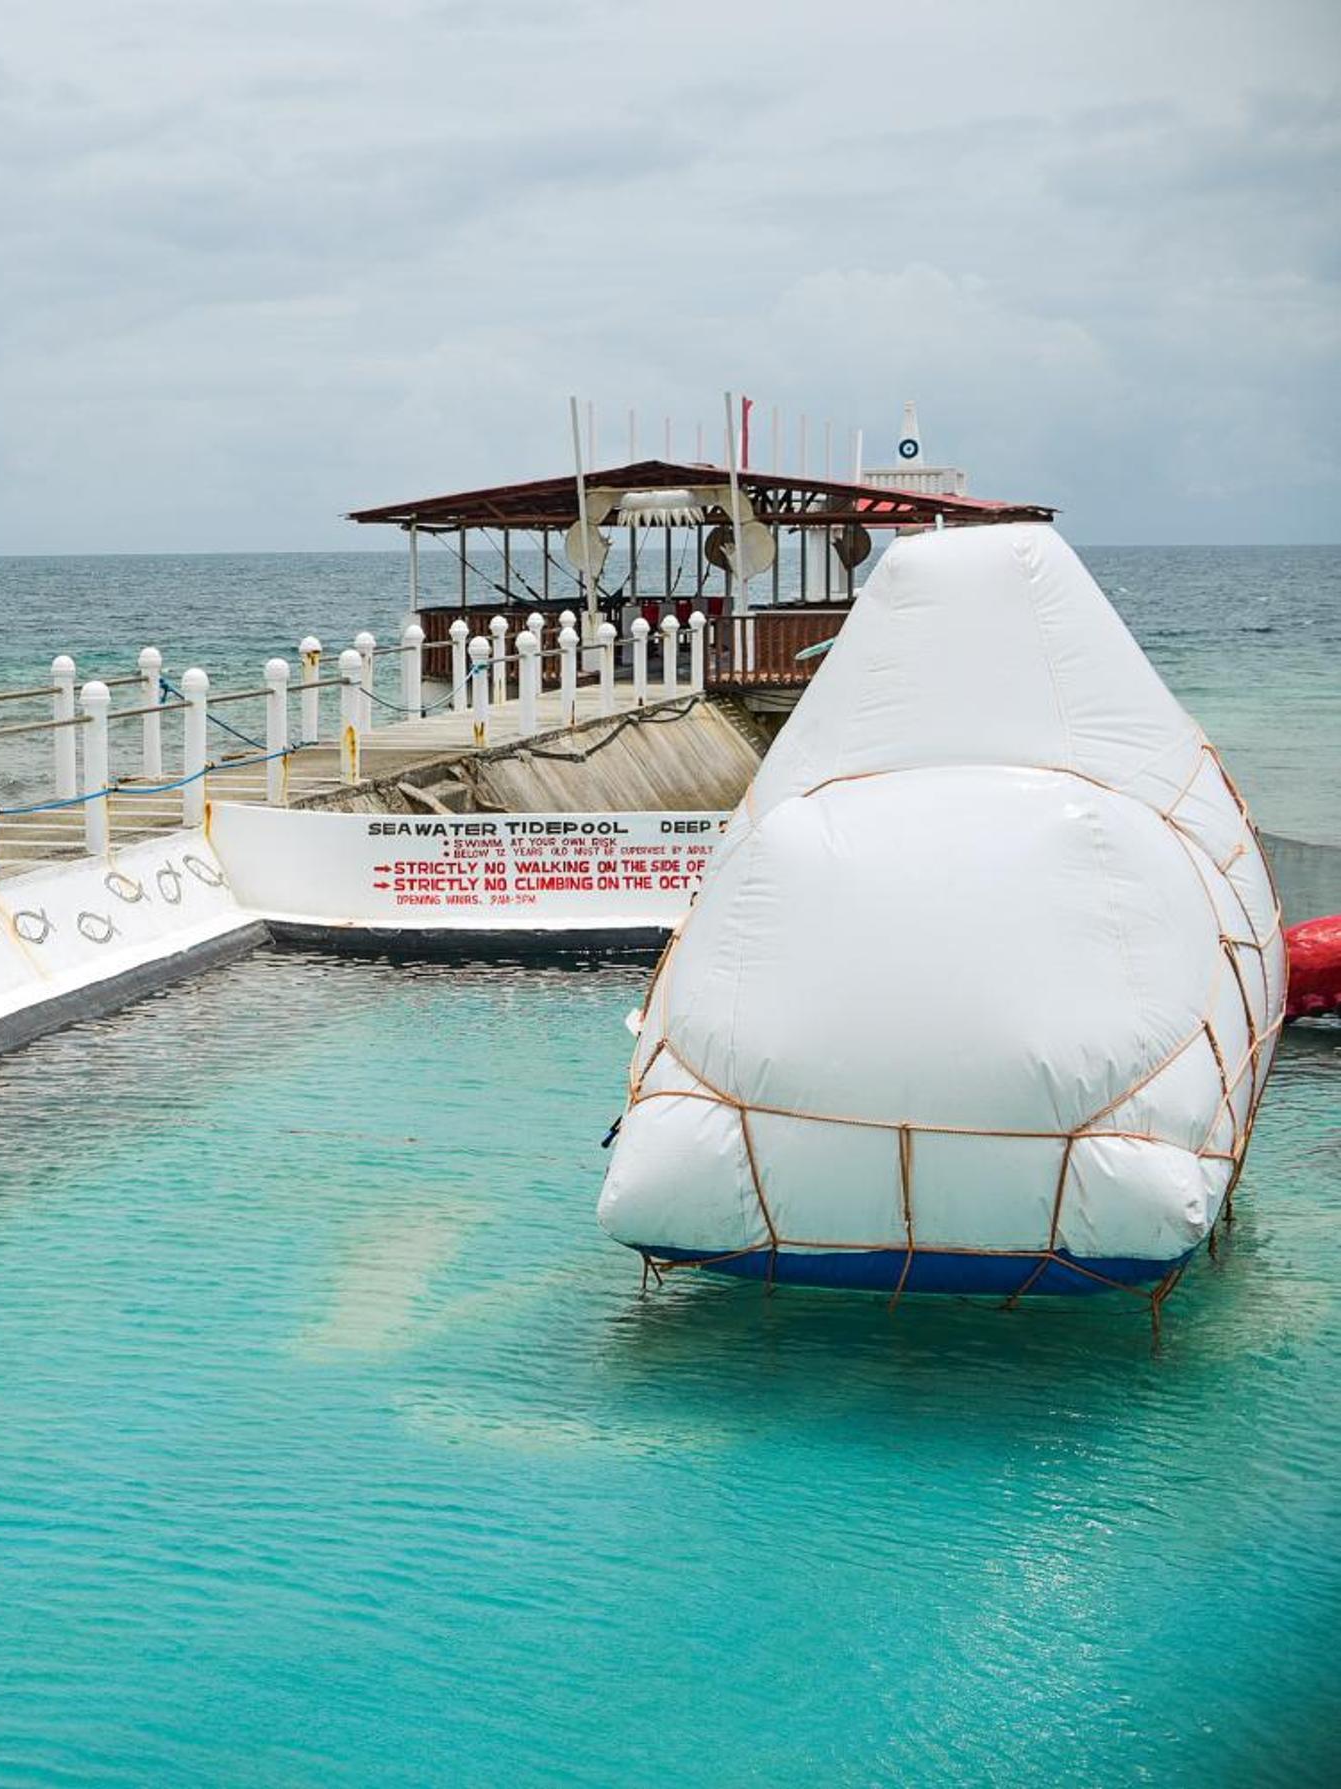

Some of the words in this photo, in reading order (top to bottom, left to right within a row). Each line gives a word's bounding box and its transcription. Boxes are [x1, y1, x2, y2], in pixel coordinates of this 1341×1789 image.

[368, 823, 497, 837] SEAWATER
[505, 821, 628, 835] TIDEPOOL
[661, 821, 711, 834] DEEP
[511, 838, 524, 846] AT
[529, 838, 556, 846] YOUR
[562, 838, 585, 846] OWN
[592, 838, 617, 847] RISK
[454, 849, 489, 858] BELOW
[514, 847, 543, 856] YEARS
[394, 862, 478, 875] STRICTLY
[485, 862, 506, 874] NO
[515, 860, 590, 873] WALKING
[597, 861, 617, 873] ON
[622, 861, 647, 872] THE
[651, 860, 680, 872] SIDE
[687, 860, 705, 872] OF
[394, 878, 479, 891] STRICTLY
[485, 877, 507, 891] NO
[515, 876, 592, 891] CLIMBING
[597, 877, 619, 889] ON
[622, 876, 652, 889] THE
